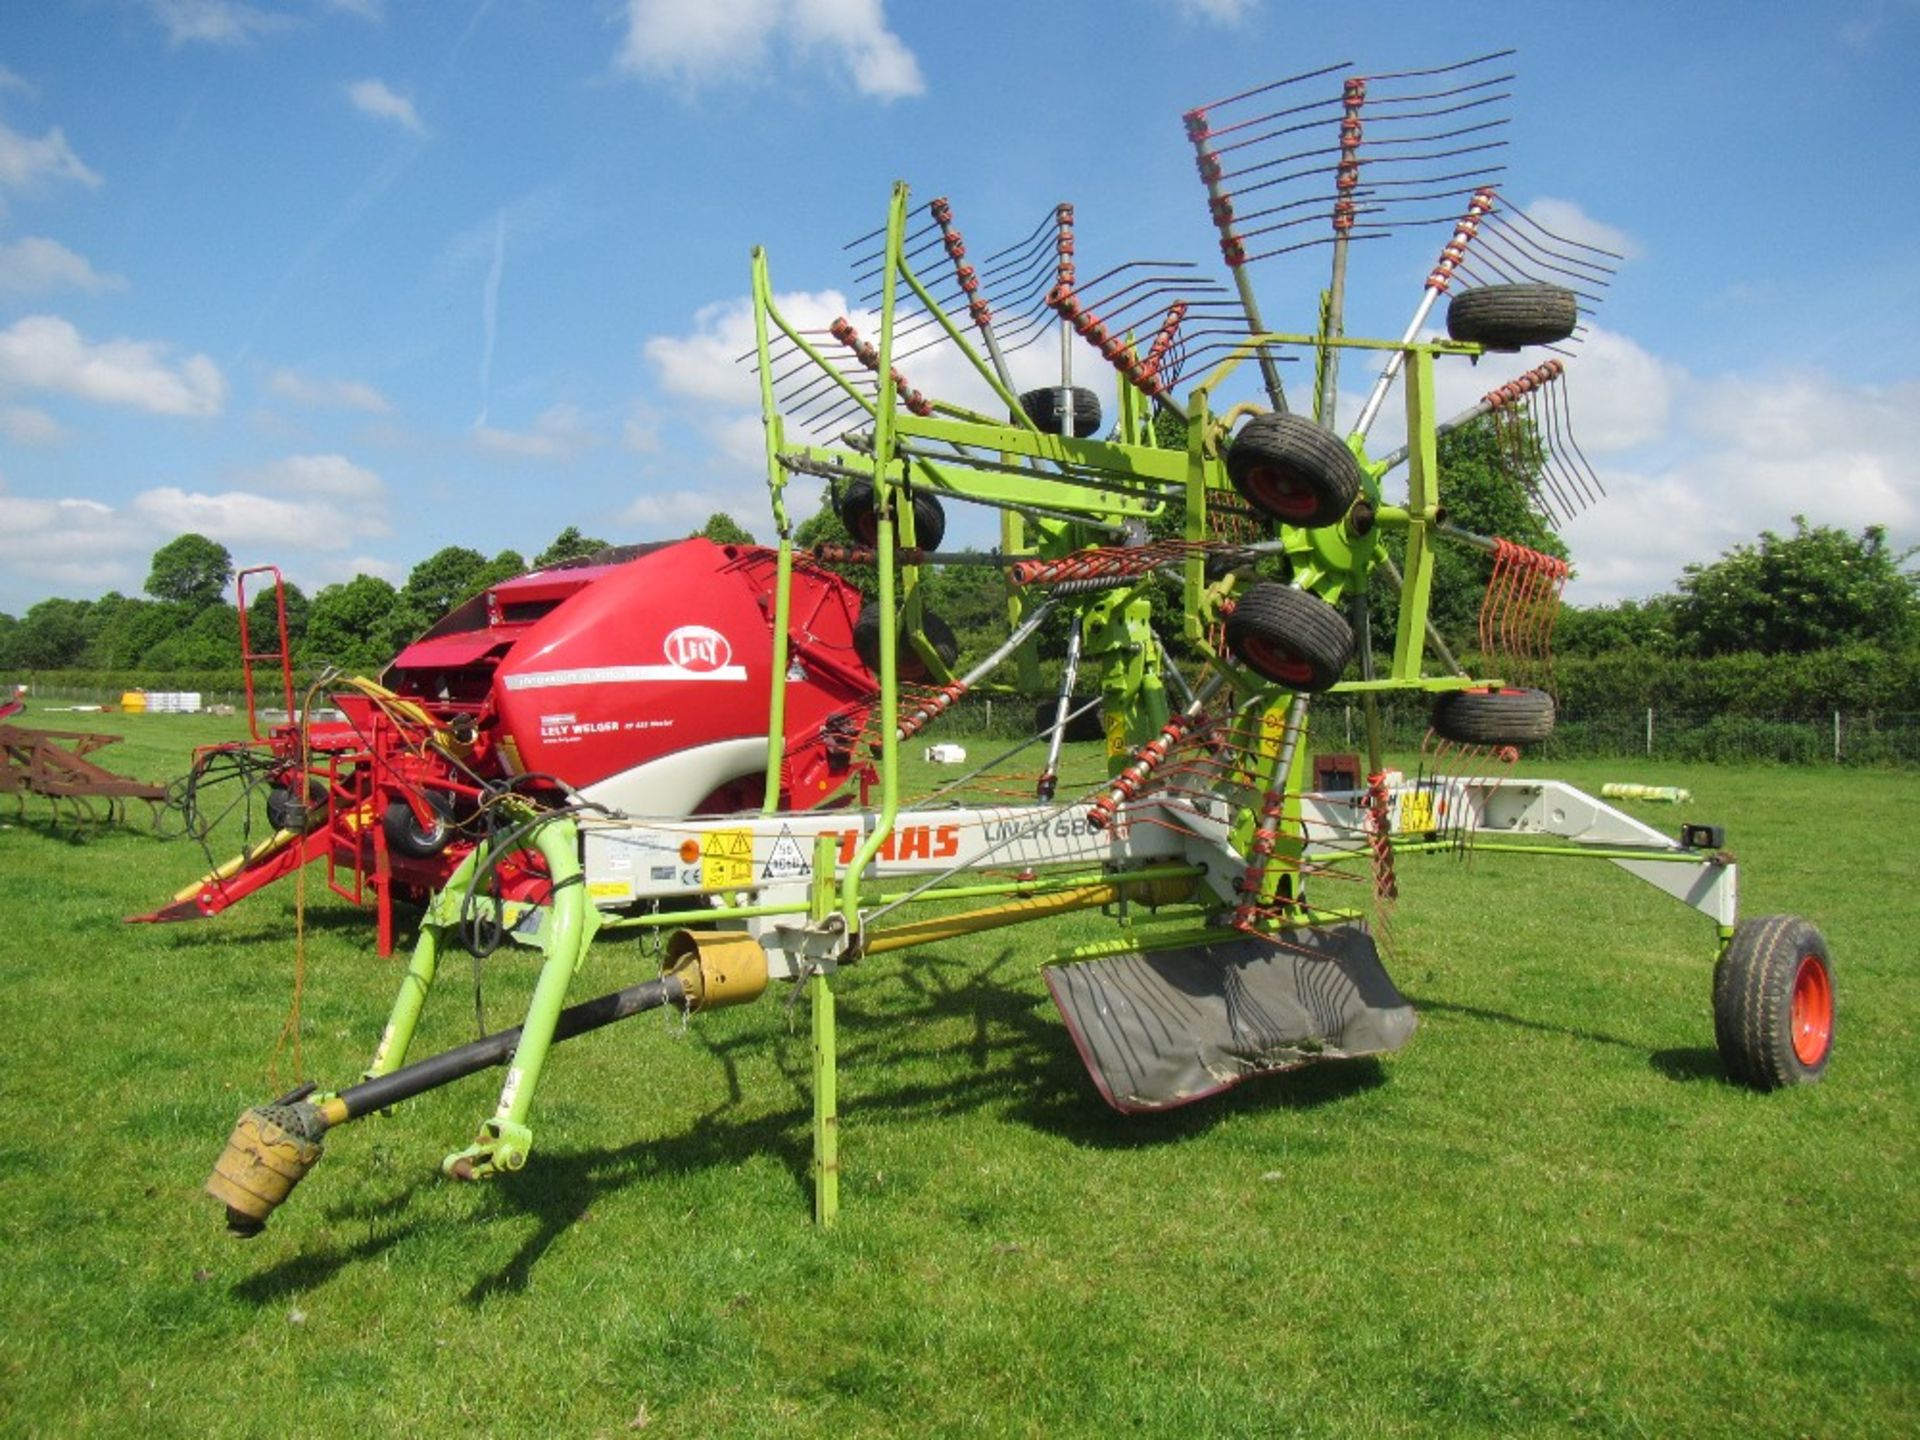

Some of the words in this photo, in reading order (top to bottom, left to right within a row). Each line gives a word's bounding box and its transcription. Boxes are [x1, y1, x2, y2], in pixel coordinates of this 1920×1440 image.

[677, 635, 717, 665] LELY
[541, 726, 569, 736] LELY
[572, 722, 619, 734] WELGER
